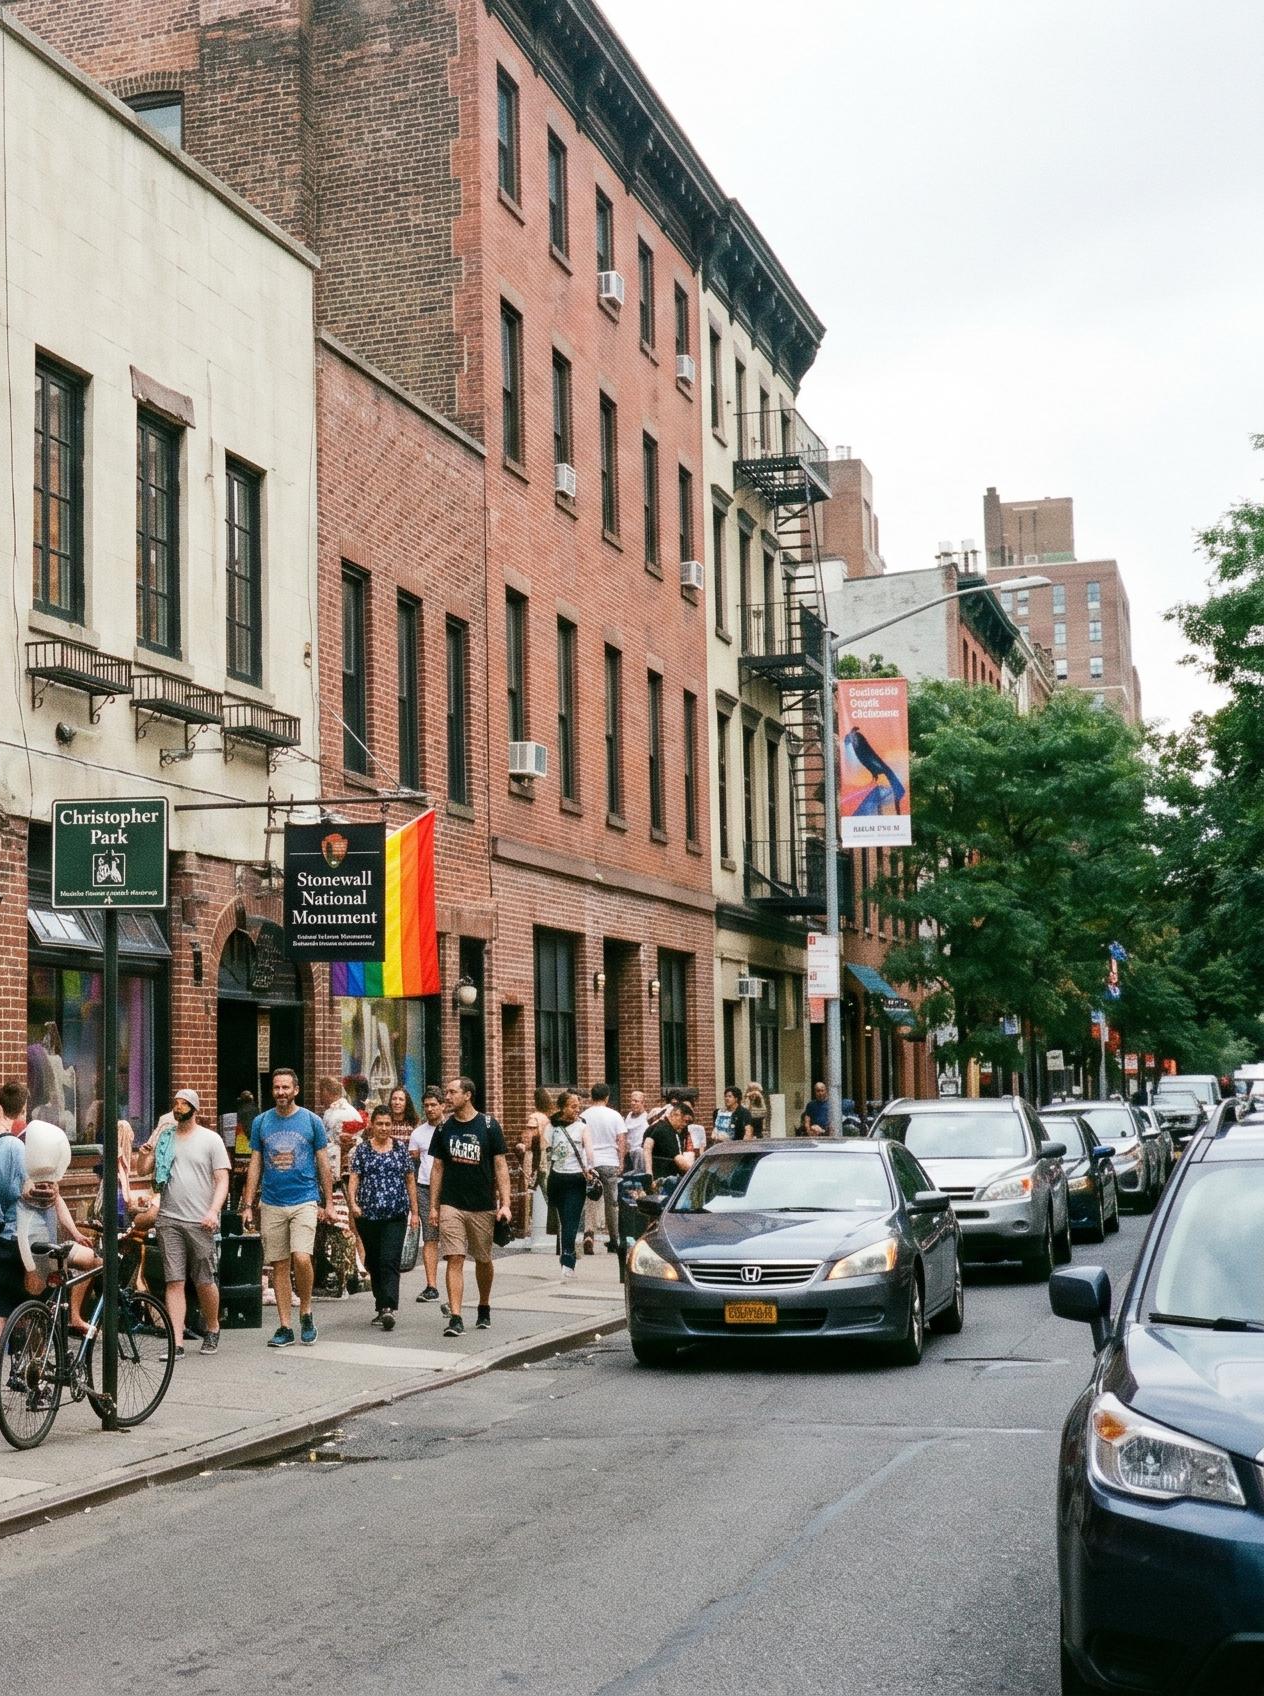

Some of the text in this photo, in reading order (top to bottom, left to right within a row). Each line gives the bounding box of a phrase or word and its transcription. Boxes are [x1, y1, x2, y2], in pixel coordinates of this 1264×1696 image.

[60, 807, 159, 828] Christopher
[90, 829, 128, 845] Park
[297, 870, 372, 887] Stonewall
[301, 889, 367, 906] National
[291, 909, 378, 925] Monument
